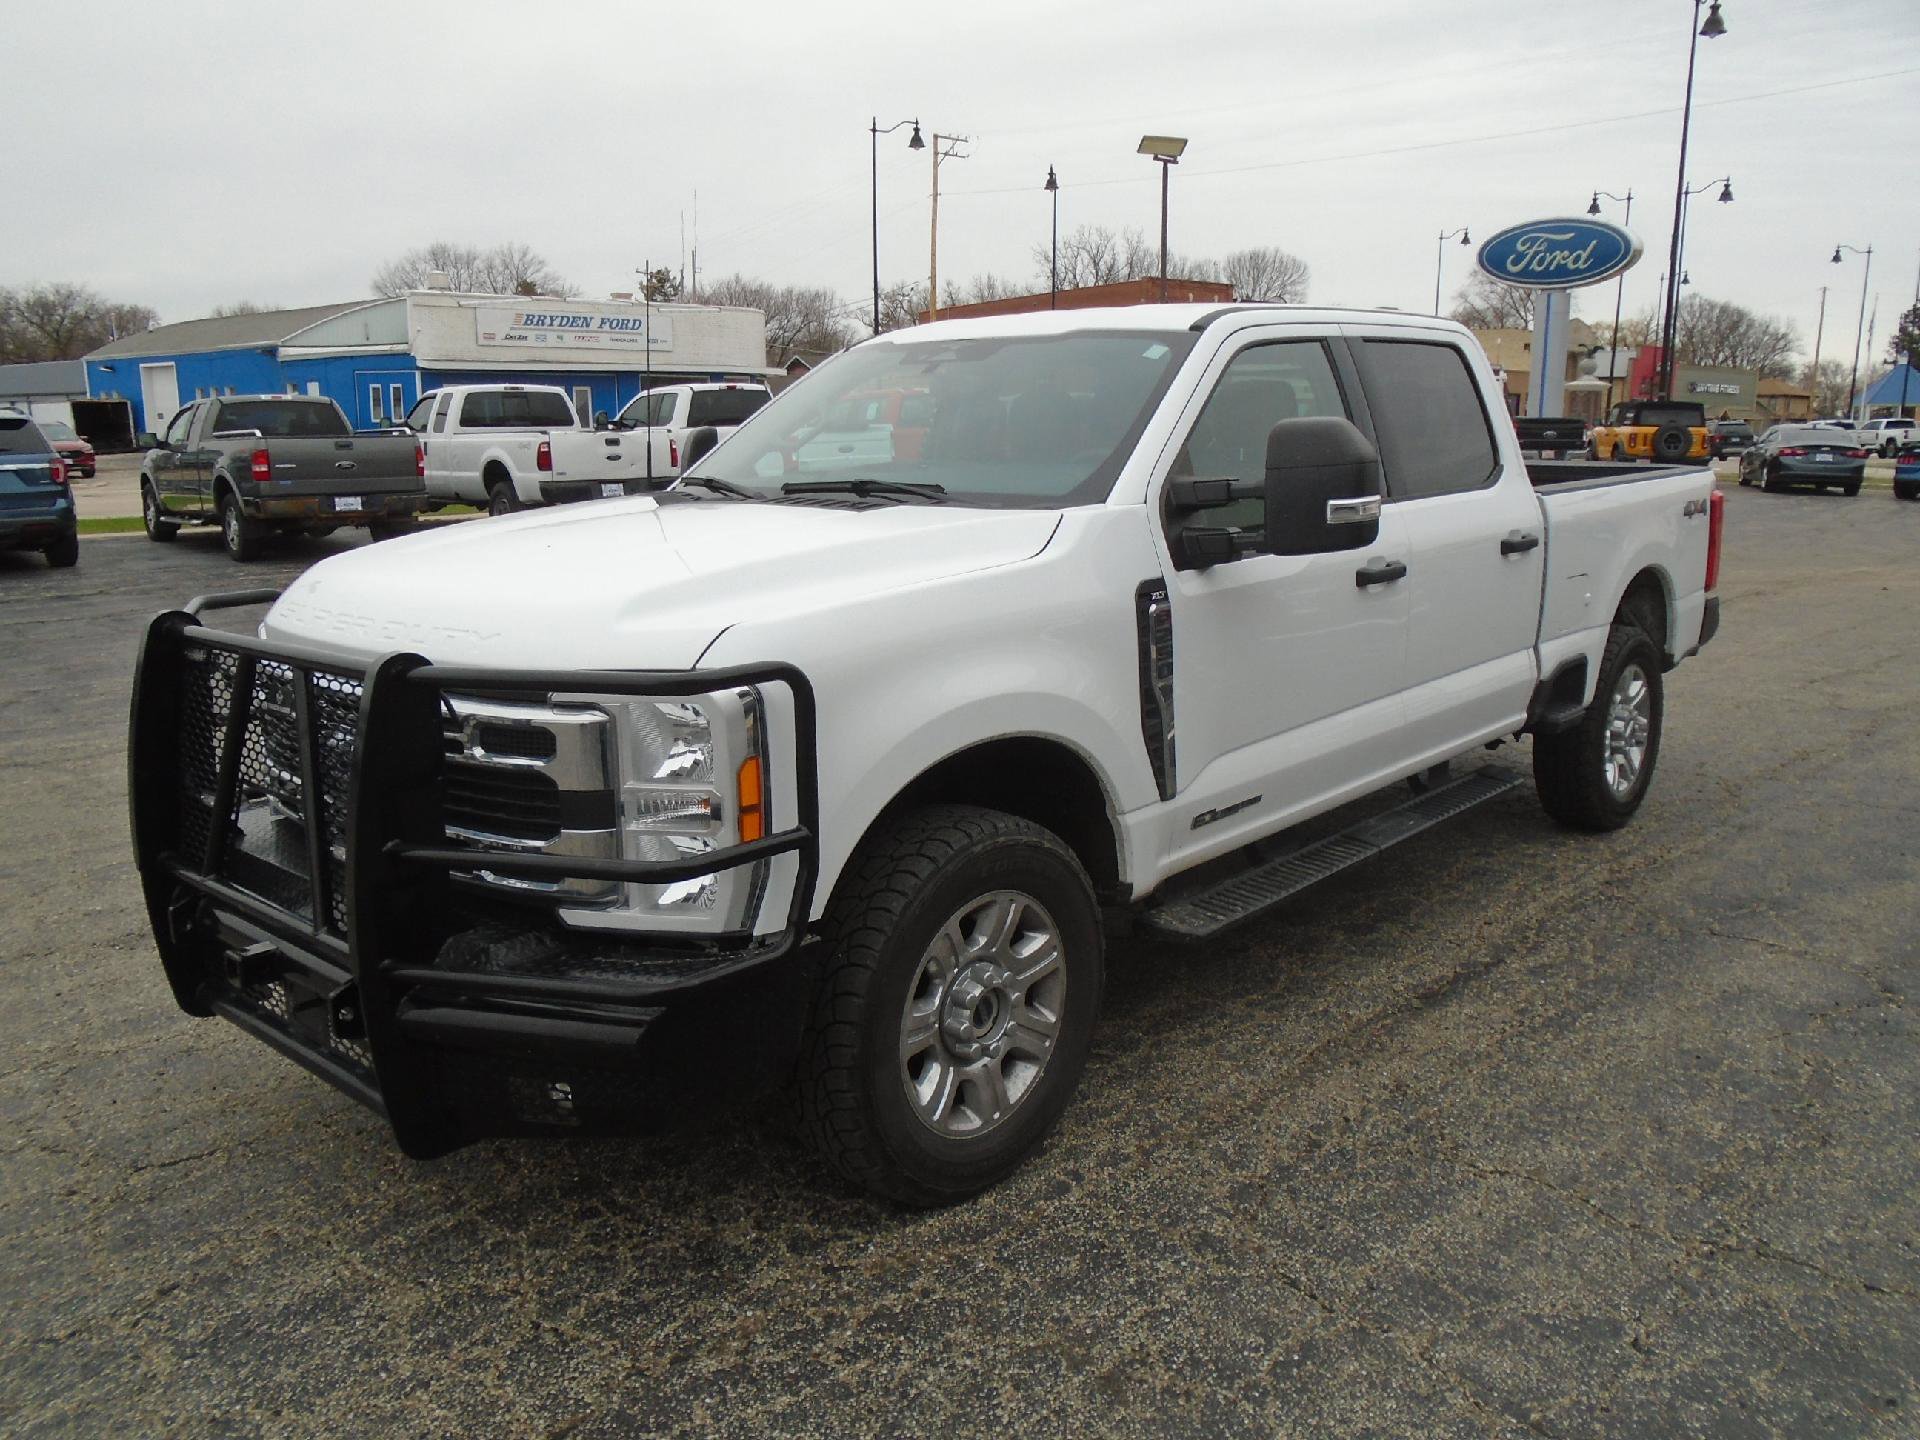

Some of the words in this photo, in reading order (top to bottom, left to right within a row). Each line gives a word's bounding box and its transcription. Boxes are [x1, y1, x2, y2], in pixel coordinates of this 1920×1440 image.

[1506, 232, 1598, 273] Ford
[523, 313, 593, 328] BRYDEN
[597, 317, 642, 331] FORD
